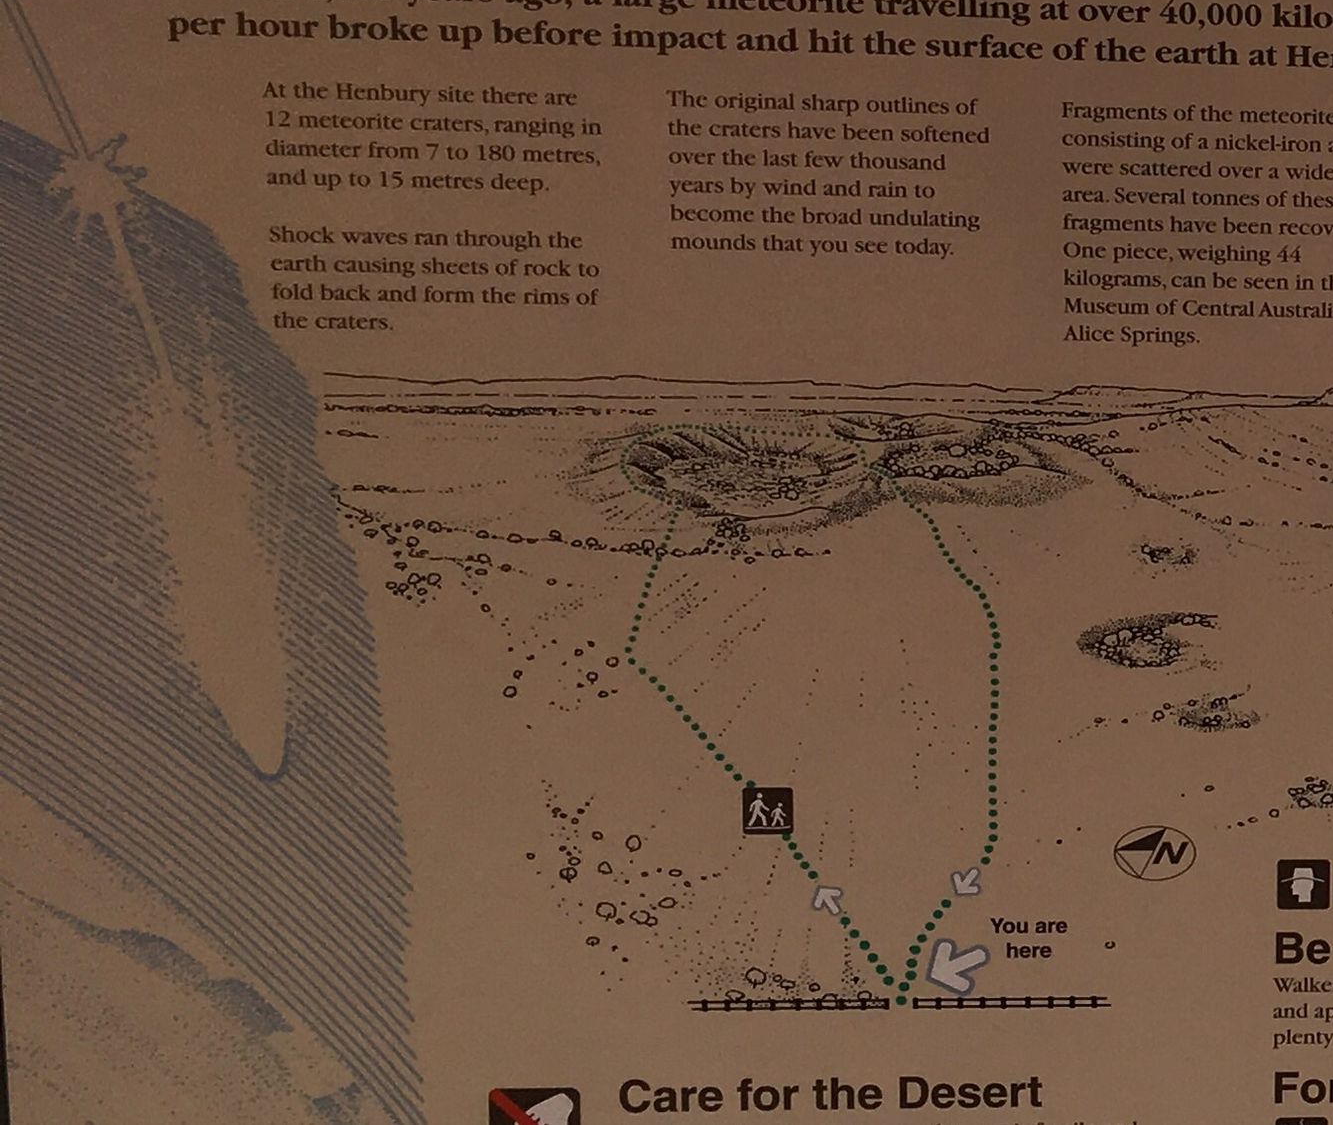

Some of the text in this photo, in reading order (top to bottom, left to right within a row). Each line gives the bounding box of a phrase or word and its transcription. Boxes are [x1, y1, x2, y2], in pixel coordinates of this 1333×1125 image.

[1040, 0, 1069, 20] at
[1078, 5, 1151, 23] over
[1160, 0, 1261, 29] 40,000
[263, 82, 577, 107] At the Henbury site there are
[666, 90, 978, 116] The original sharp outlines of
[1065, 298, 1149, 314] Museum
[1156, 299, 1178, 315] of
[1183, 300, 1254, 316] Central
[1064, 325, 1200, 347] Alice Springs.
[991, 918, 1067, 934] You are
[1007, 943, 1052, 958] here
[1276, 932, 1330, 964] Be
[620, 1077, 1042, 1113] Care for the Desert
